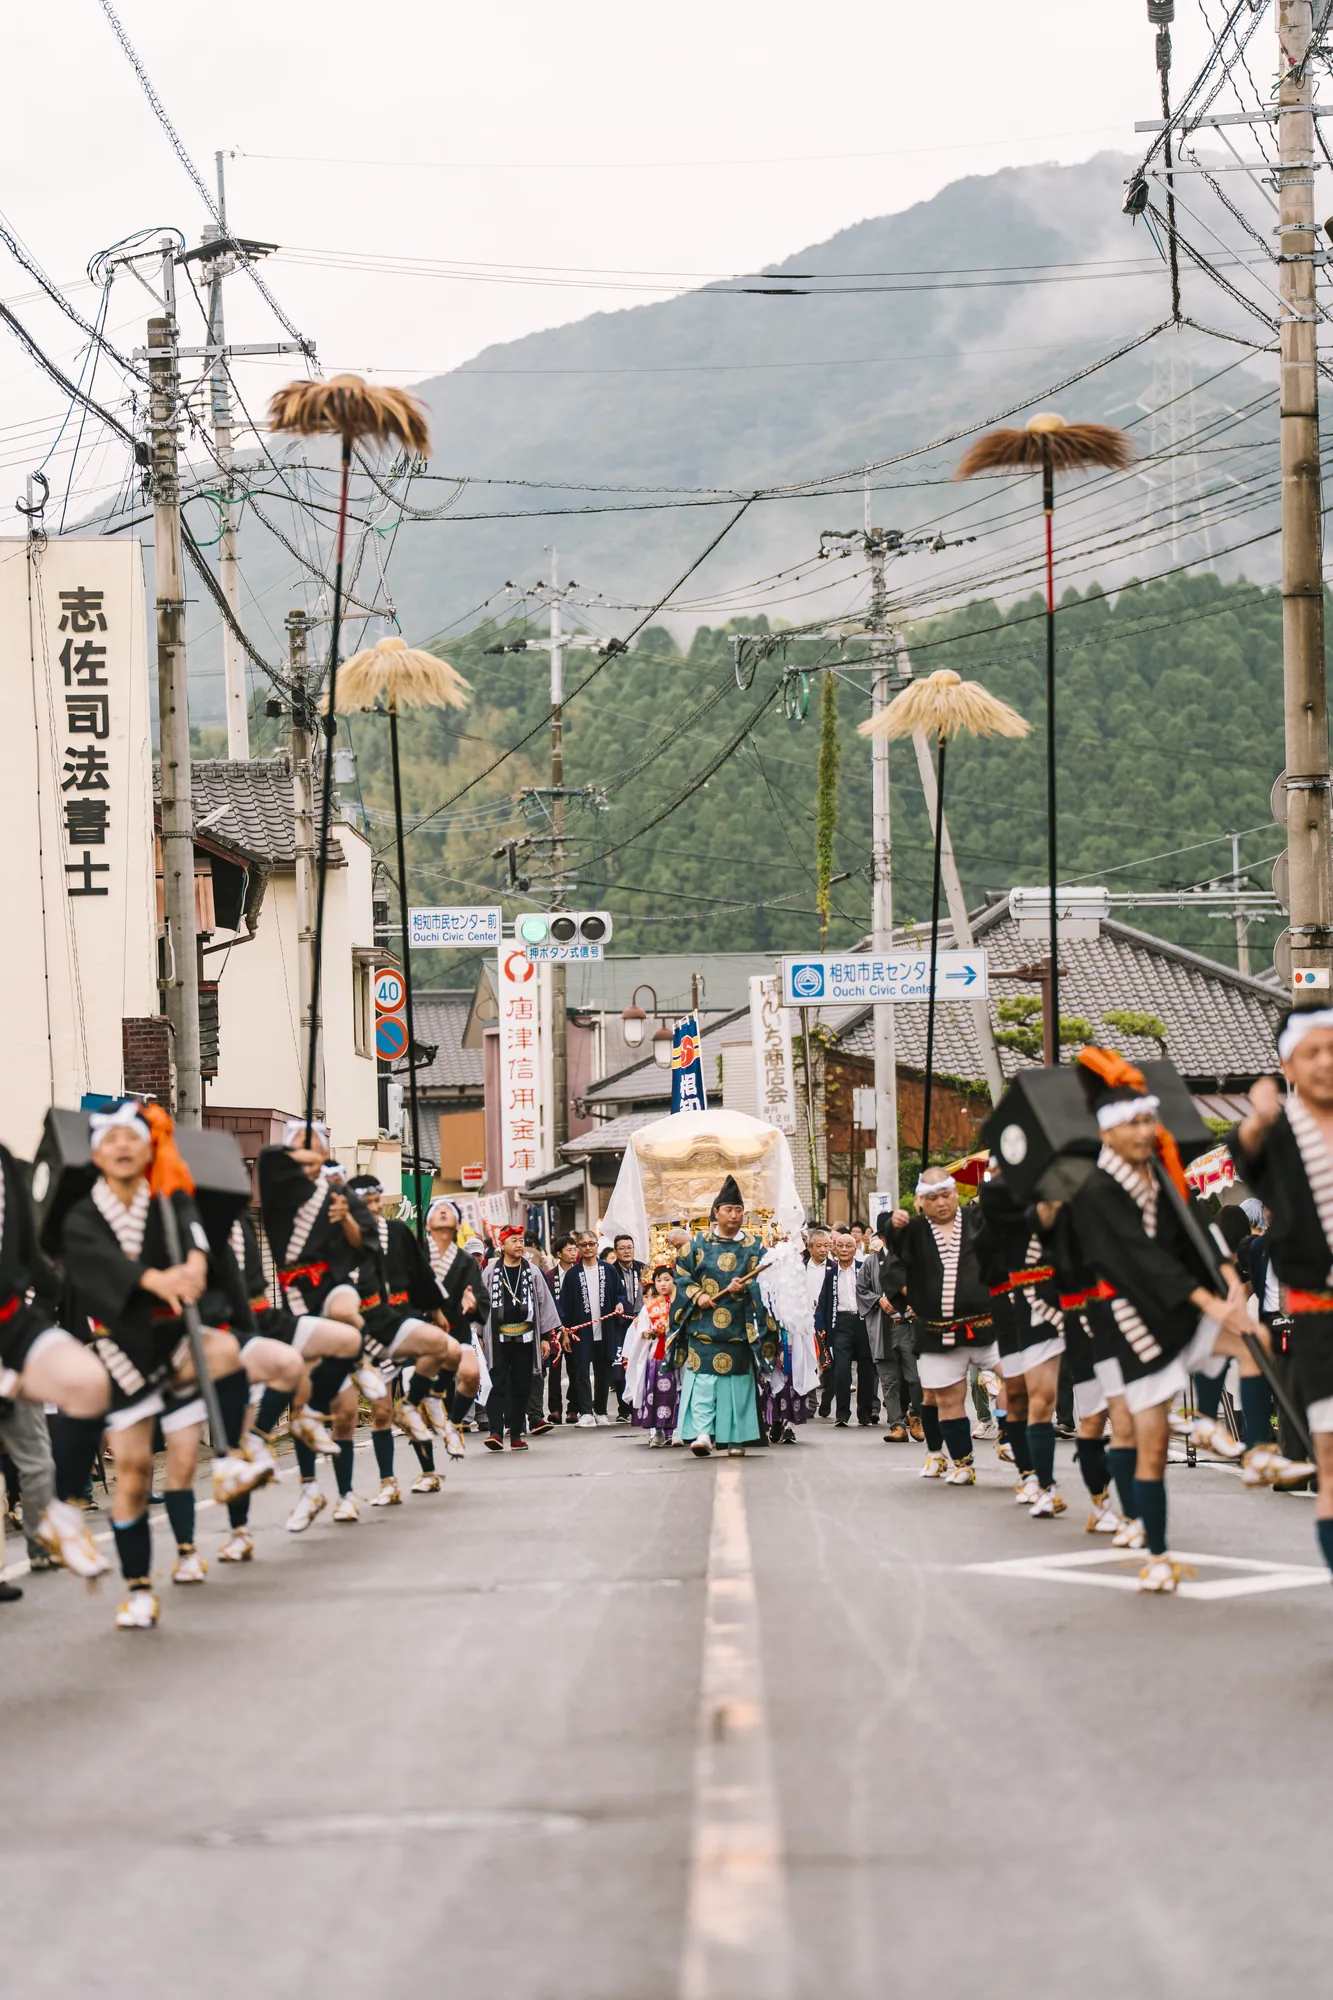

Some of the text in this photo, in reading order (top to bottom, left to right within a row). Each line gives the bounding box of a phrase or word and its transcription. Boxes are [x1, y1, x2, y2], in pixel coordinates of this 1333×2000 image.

[58, 586, 110, 896] 志佐司法書士
[412, 913, 498, 930] 相知市民センター前
[413, 931, 498, 942] Ouchi Civic Center
[529, 945, 600, 960] 押ボタン式信号
[829, 961, 938, 983] 相知市民センタ
[378, 981, 399, 1001] 40
[833, 984, 865, 997] Ouchi
[869, 983, 896, 996] Civic
[506, 996, 536, 1172] 唐津信用金庫
